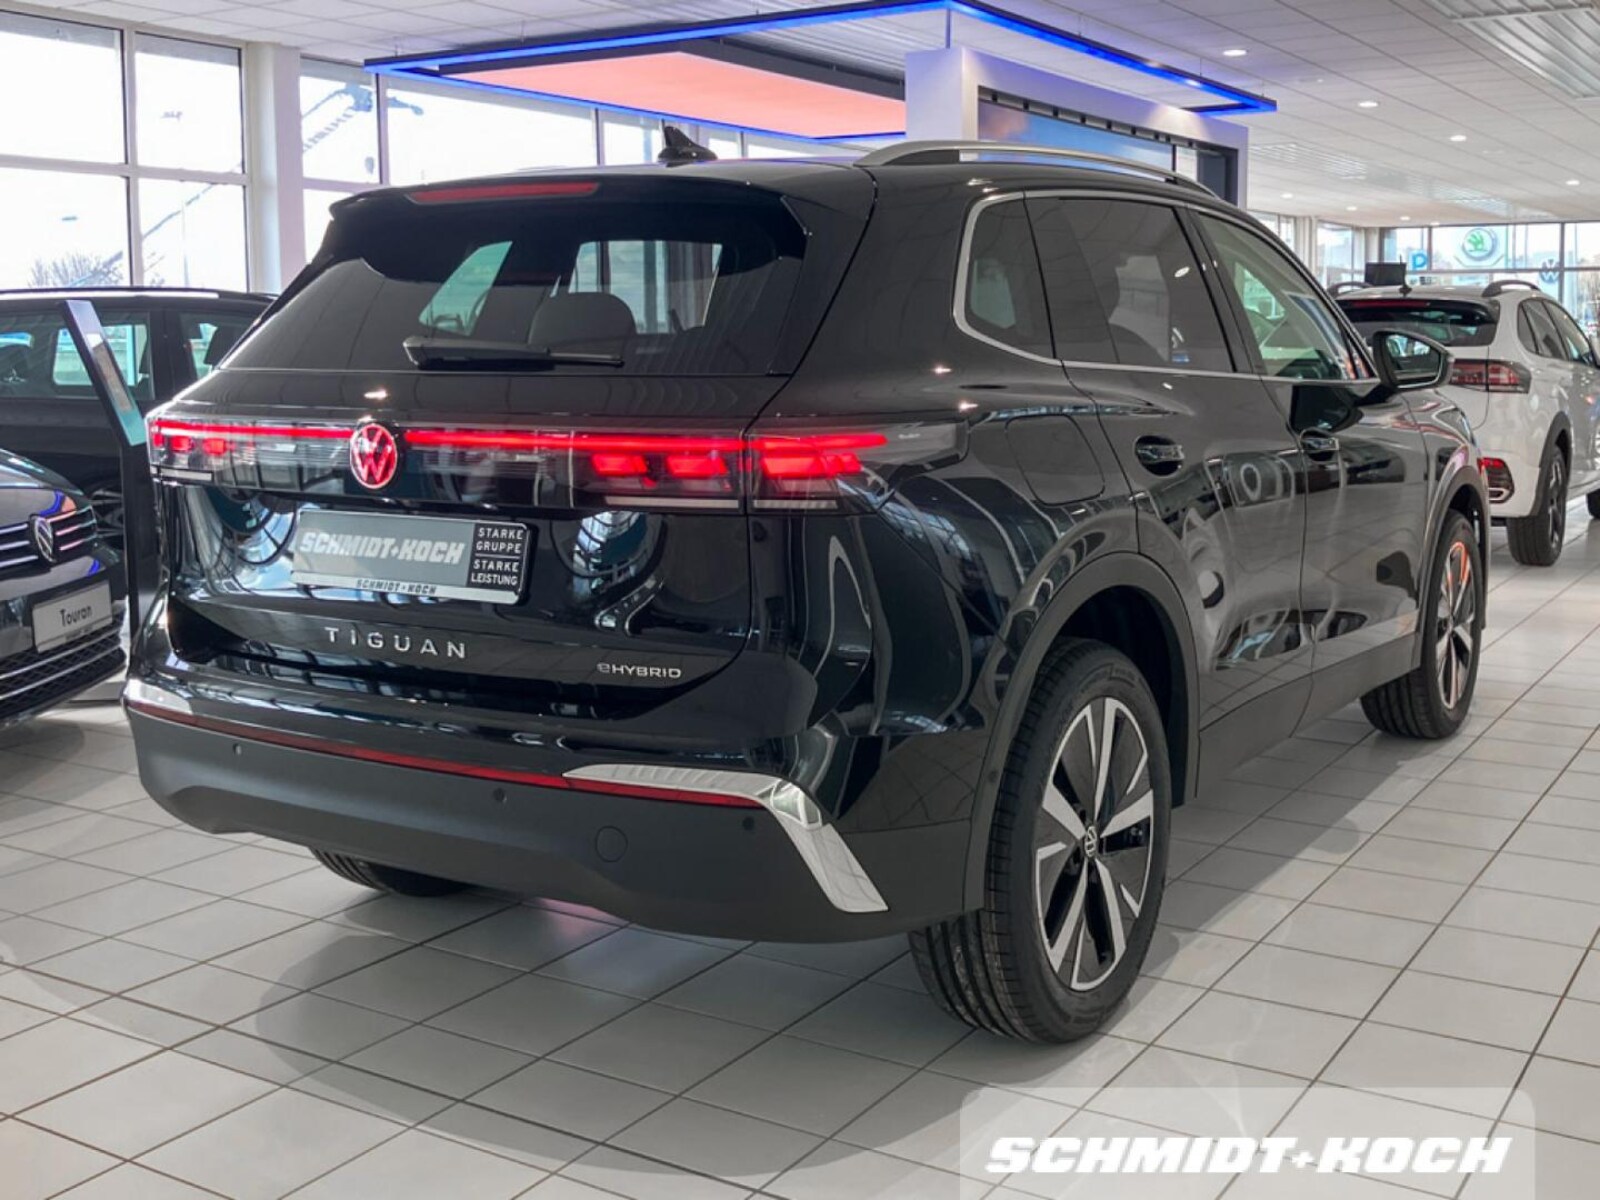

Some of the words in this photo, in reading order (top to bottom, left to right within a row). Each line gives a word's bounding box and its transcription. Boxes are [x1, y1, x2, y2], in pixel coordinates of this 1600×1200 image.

[478, 527, 524, 540] STARKE
[476, 540, 522, 554] GRUPPE
[473, 559, 519, 573] STARKE
[471, 572, 518, 586] LEISTUNG
[60, 605, 92, 628] Touran
[325, 626, 466, 659] TIGUAN
